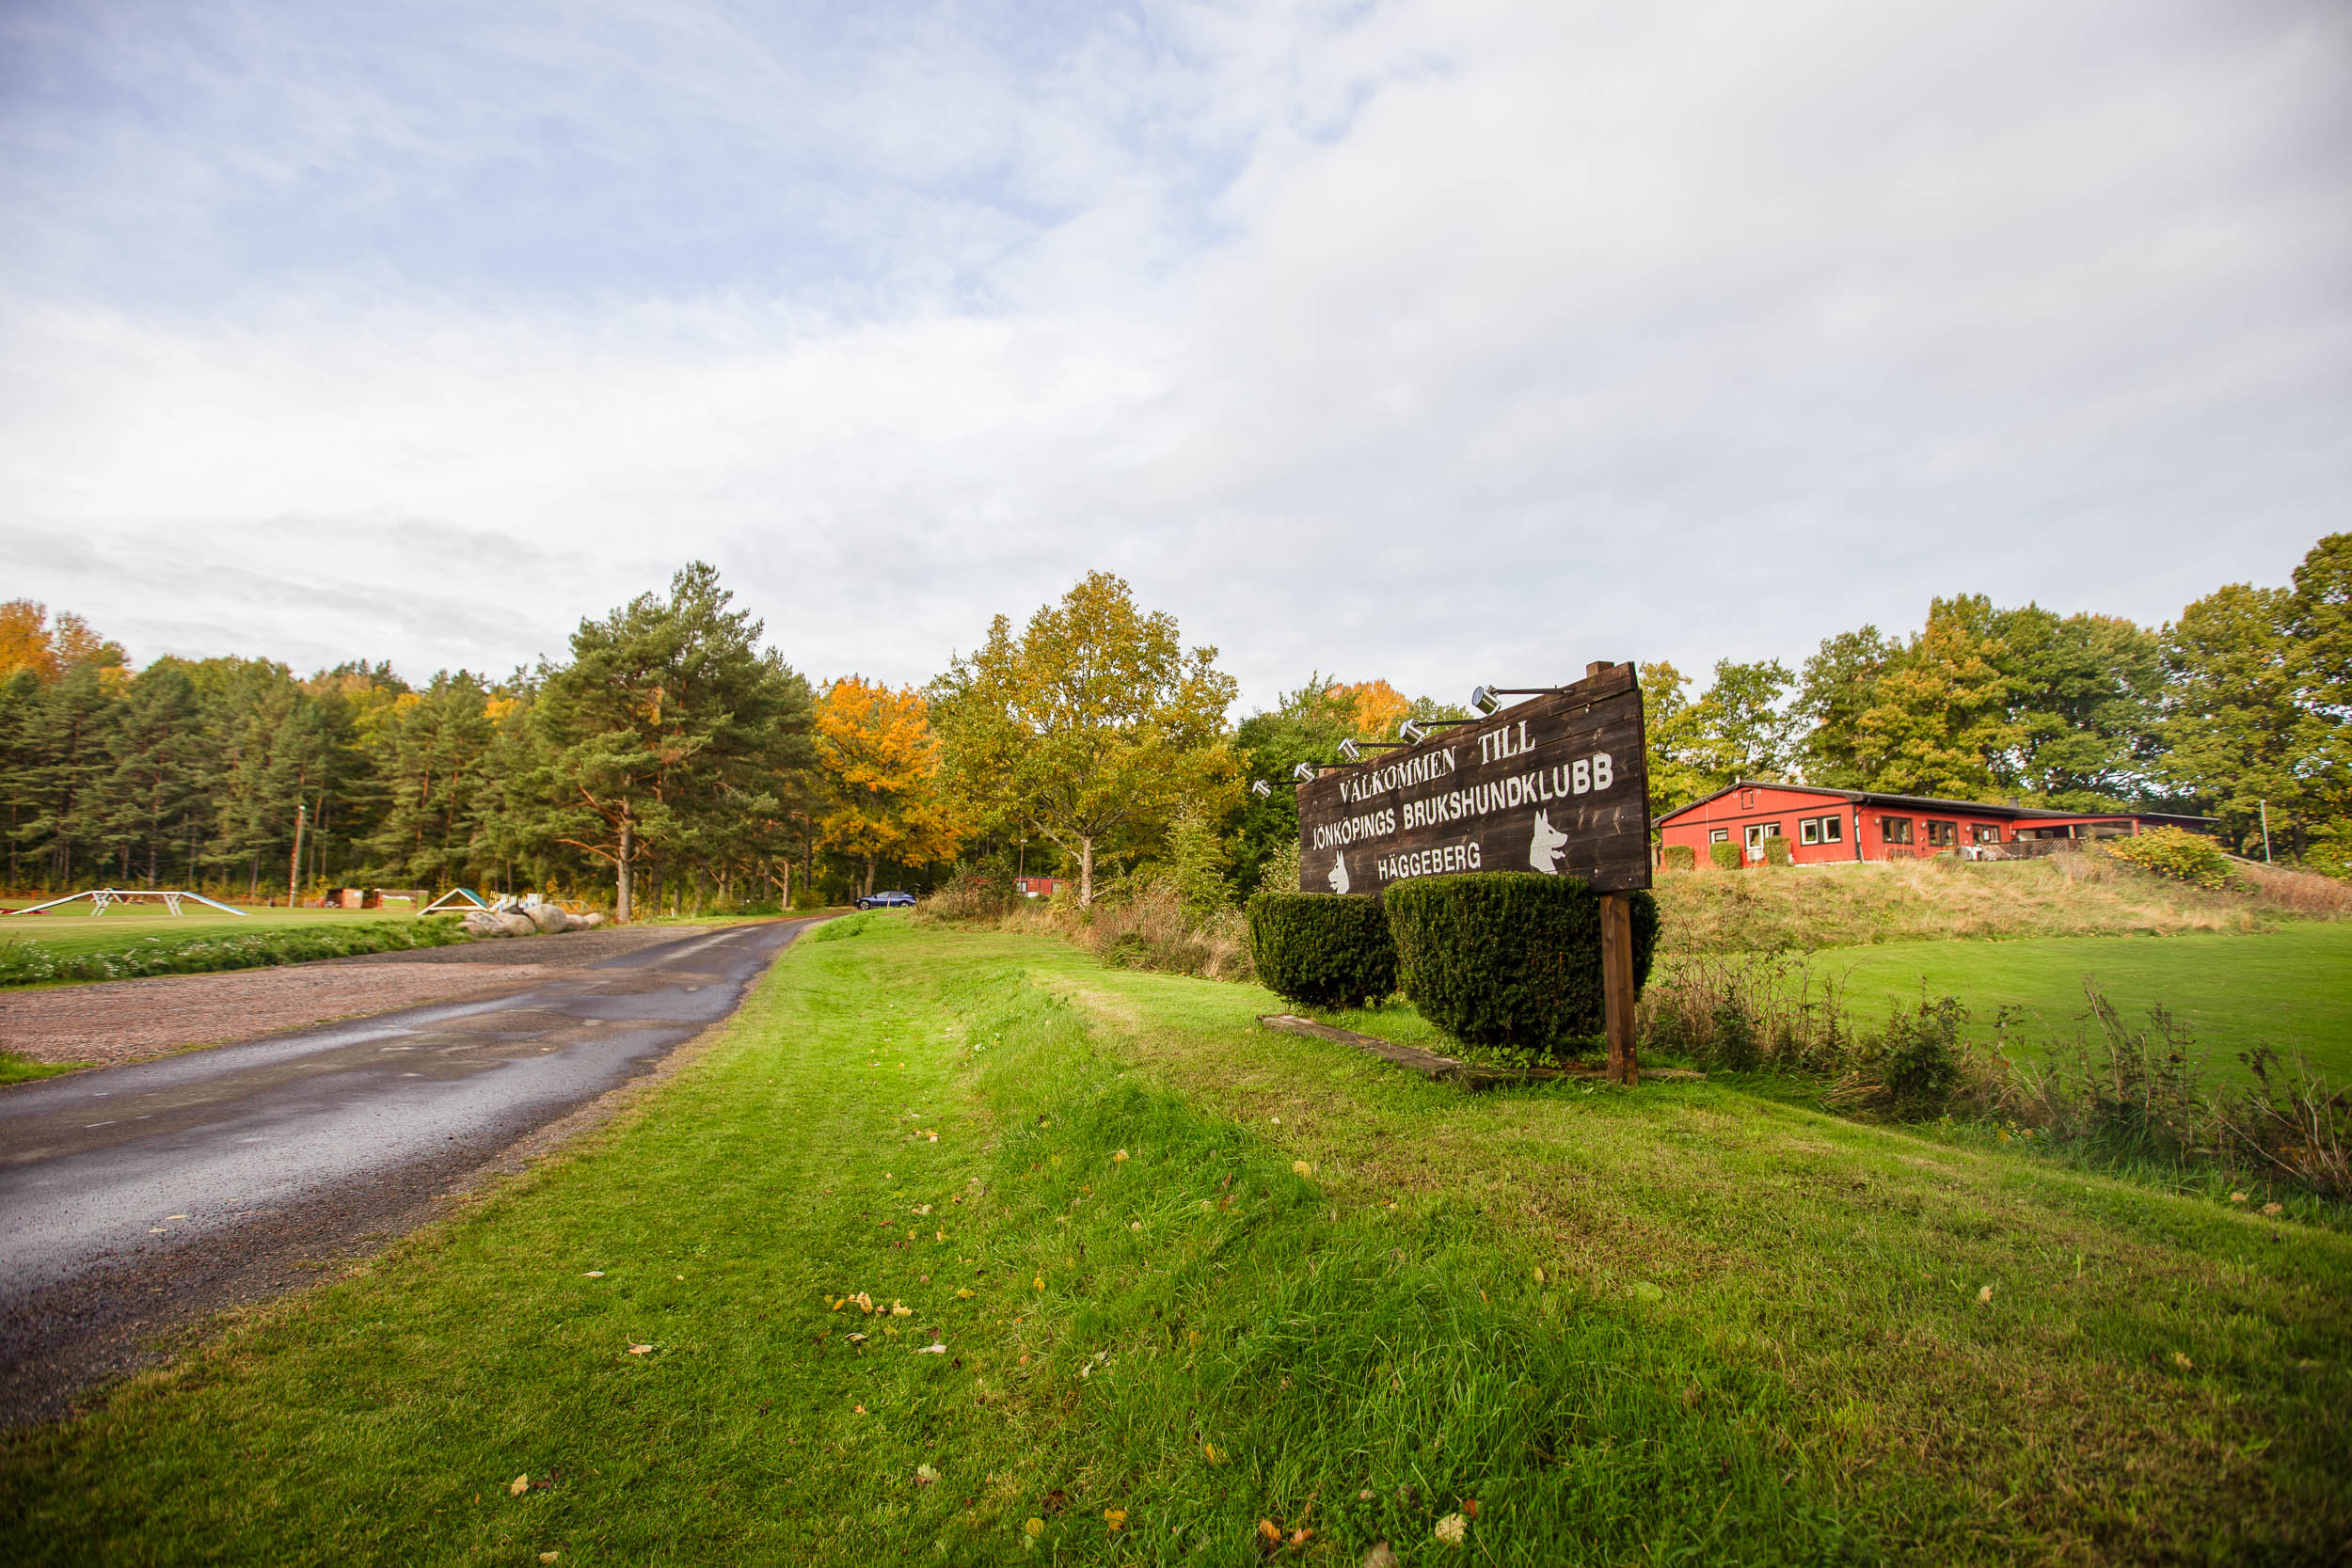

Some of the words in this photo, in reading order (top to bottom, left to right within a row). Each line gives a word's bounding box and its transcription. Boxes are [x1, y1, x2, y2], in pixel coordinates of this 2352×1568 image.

[1312, 808, 1396, 850] JÖNKÖPINGS
[1404, 753, 1613, 830] BRUKSHUNDKLUBB
[1340, 746, 1456, 803] VÄLKOMMEN
[1477, 721, 1535, 765] TILL
[1377, 842, 1482, 880] HÄGGEBERG
